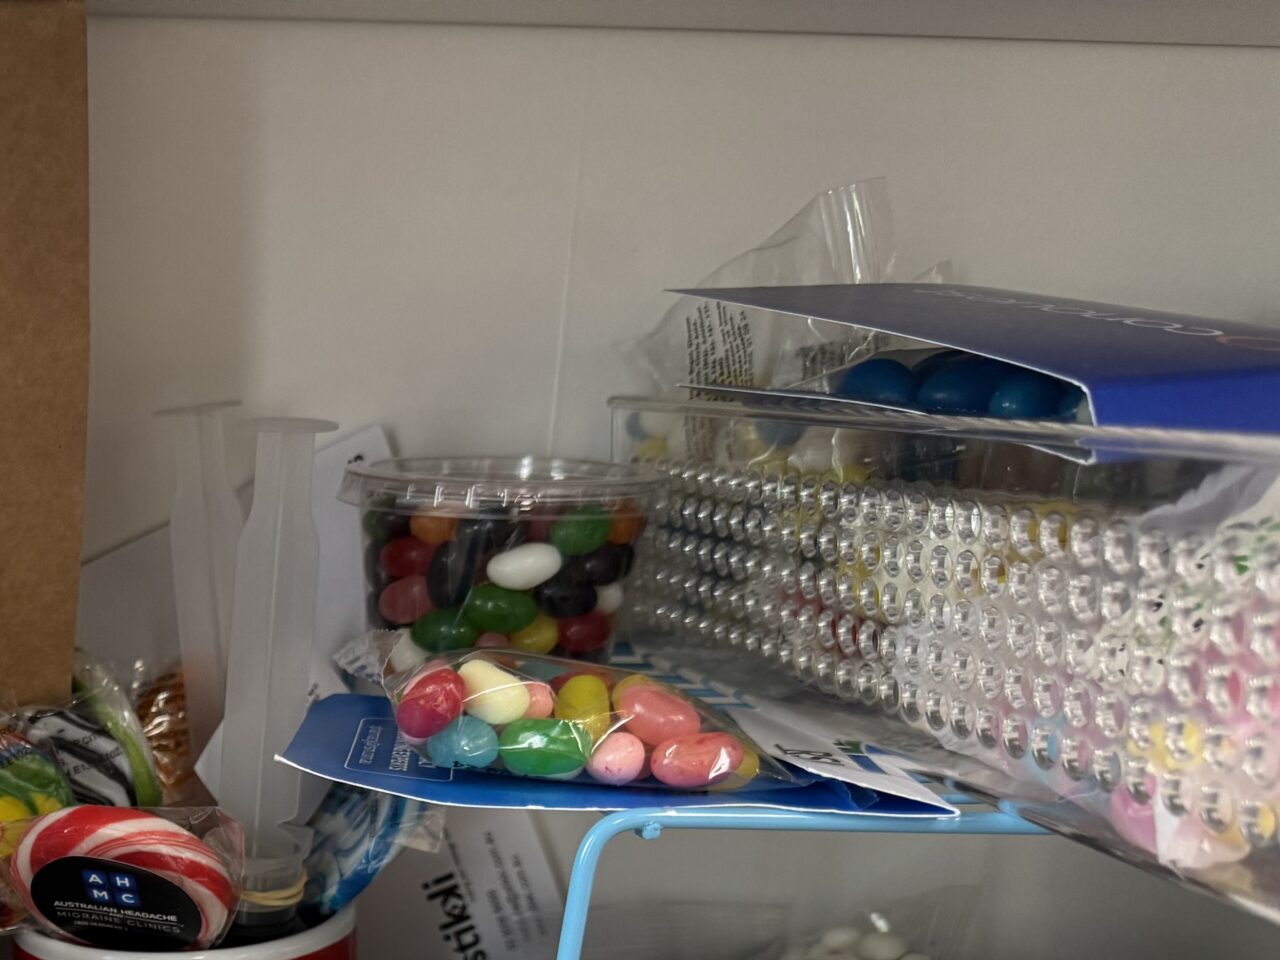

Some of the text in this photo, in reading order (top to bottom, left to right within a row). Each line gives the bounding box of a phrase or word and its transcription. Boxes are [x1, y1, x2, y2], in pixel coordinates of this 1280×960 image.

[53, 900, 178, 922] AUSTRALIAN HEADACHE
[57, 911, 182, 934] MIGRAINE CLINICS
